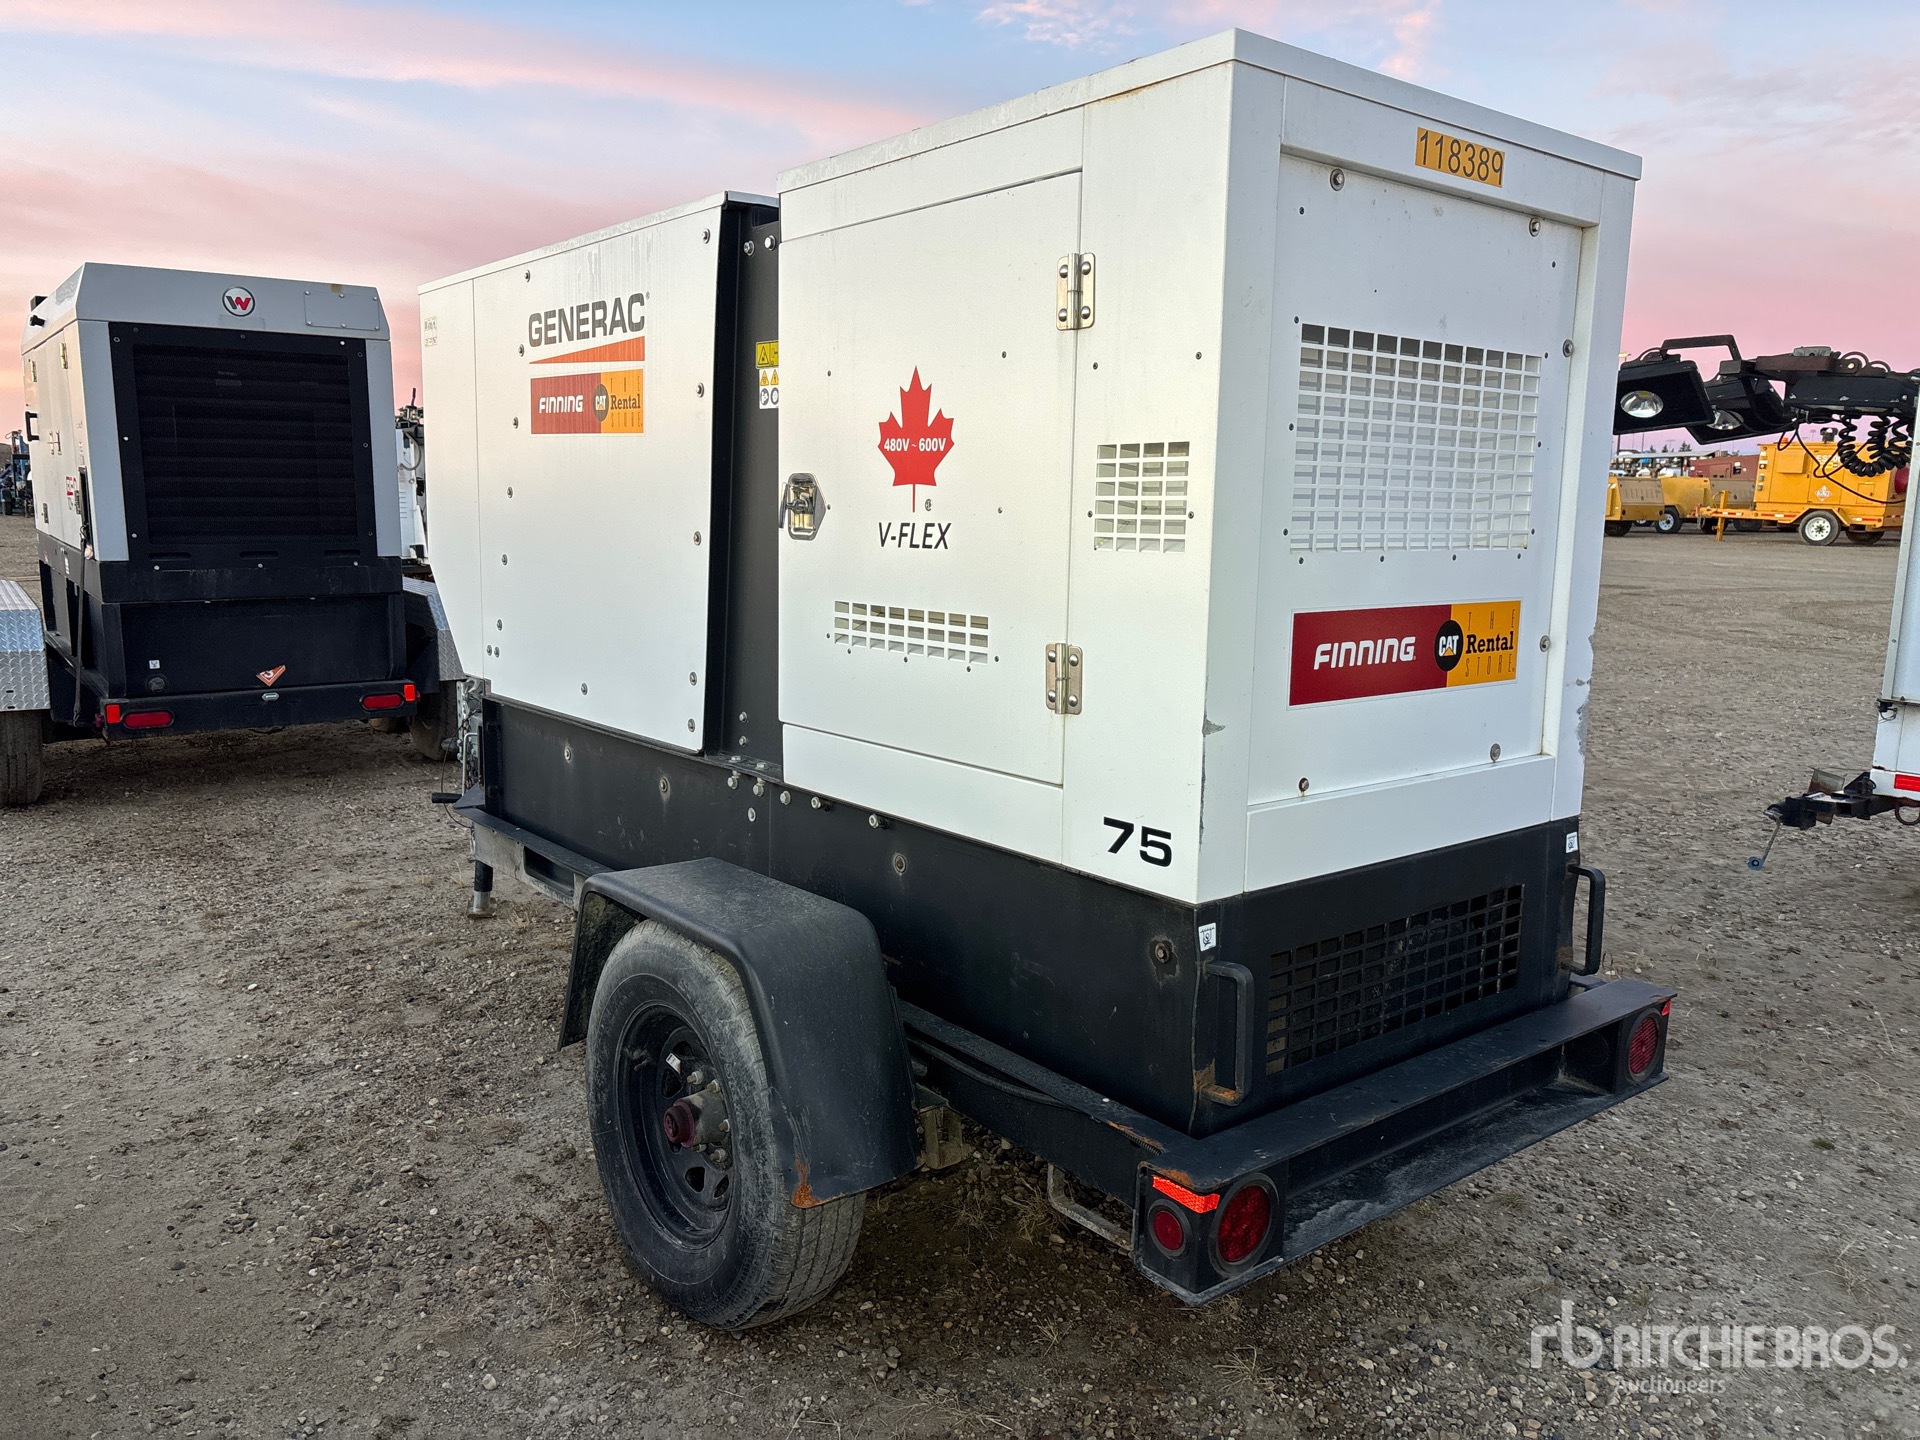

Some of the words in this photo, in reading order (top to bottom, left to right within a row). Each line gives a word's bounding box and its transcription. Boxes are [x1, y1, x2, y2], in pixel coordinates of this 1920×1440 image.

[1420, 130, 1503, 185] 118389
[528, 292, 645, 347] GENERAC
[539, 395, 584, 413] FINNING
[595, 395, 607, 410] CAT
[610, 393, 641, 410] Rental
[883, 438, 910, 452] 480V
[918, 437, 946, 452] 600V
[878, 522, 952, 550] V-FLEX
[1468, 609, 1516, 632] THE
[1313, 636, 1416, 670] FINNING
[1438, 635, 1460, 657] CAT
[1465, 630, 1514, 655] Rental
[1464, 653, 1513, 678] STORE
[1103, 816, 1172, 867] 75
